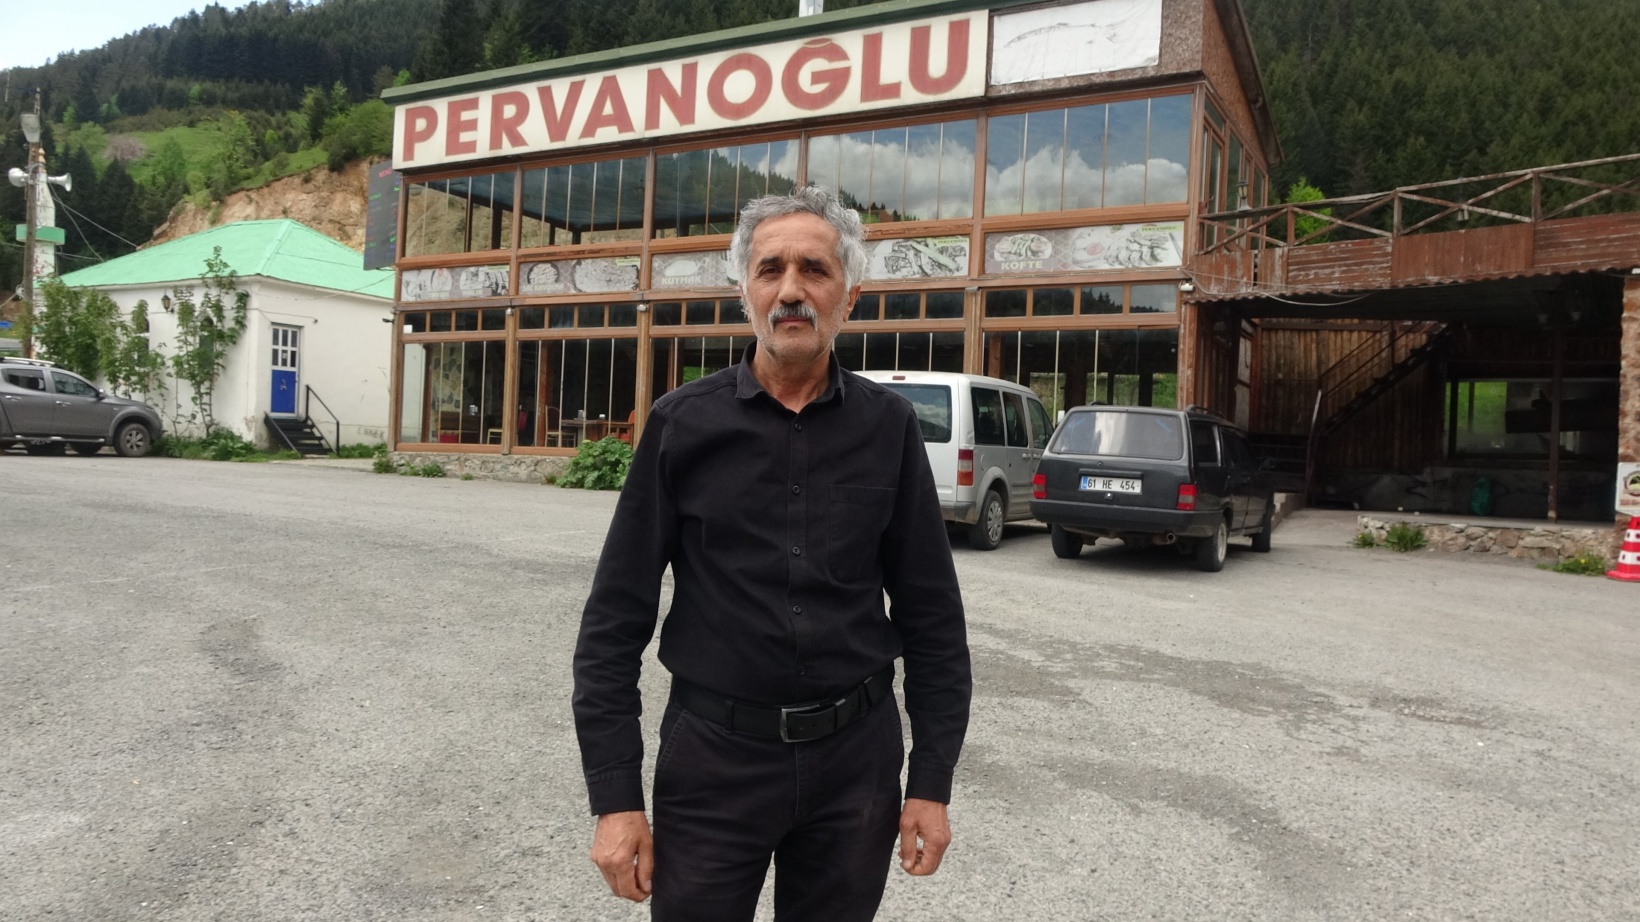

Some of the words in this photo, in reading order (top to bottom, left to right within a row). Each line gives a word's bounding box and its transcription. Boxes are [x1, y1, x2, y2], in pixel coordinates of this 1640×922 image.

[402, 19, 970, 162] PERVANOĞLU
[661, 276, 702, 285] KUYMAK
[1087, 478, 1096, 488] 61
[1102, 479, 1113, 489] HE
[1120, 480, 1136, 491] 454
